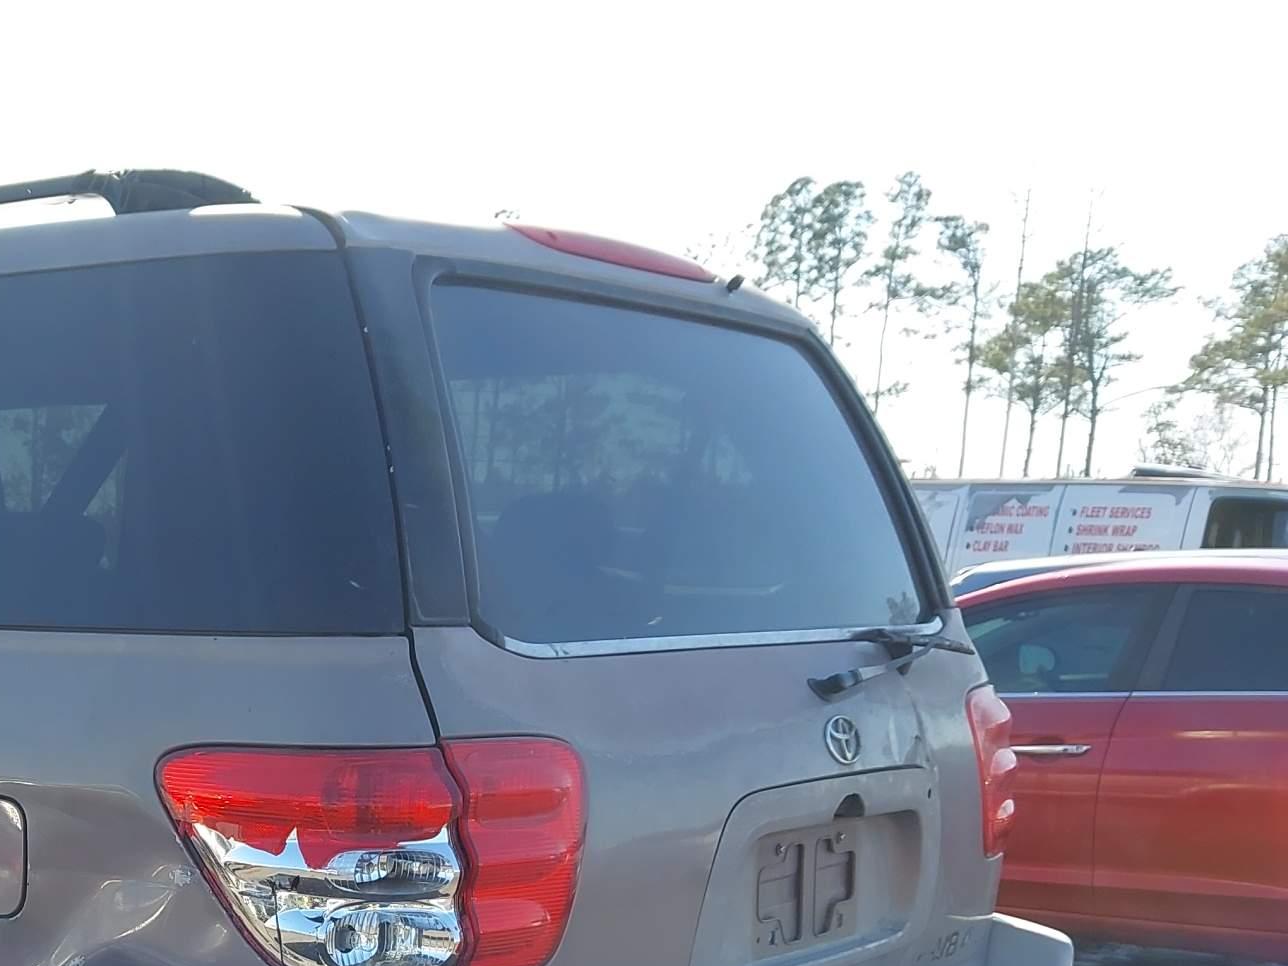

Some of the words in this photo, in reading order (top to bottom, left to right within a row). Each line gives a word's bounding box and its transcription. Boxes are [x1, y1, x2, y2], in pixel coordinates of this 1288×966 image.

[1016, 505, 1049, 517] COATING
[1080, 506, 1107, 518] FLEET
[1109, 506, 1152, 519] SERVICES
[1006, 523, 1024, 534] WAX
[1076, 524, 1110, 536] SHRINK
[1111, 525, 1138, 537] WRAP
[972, 540, 992, 552] CLAY
[992, 540, 1009, 552] BAR
[1072, 542, 1114, 554] INTERIOR
